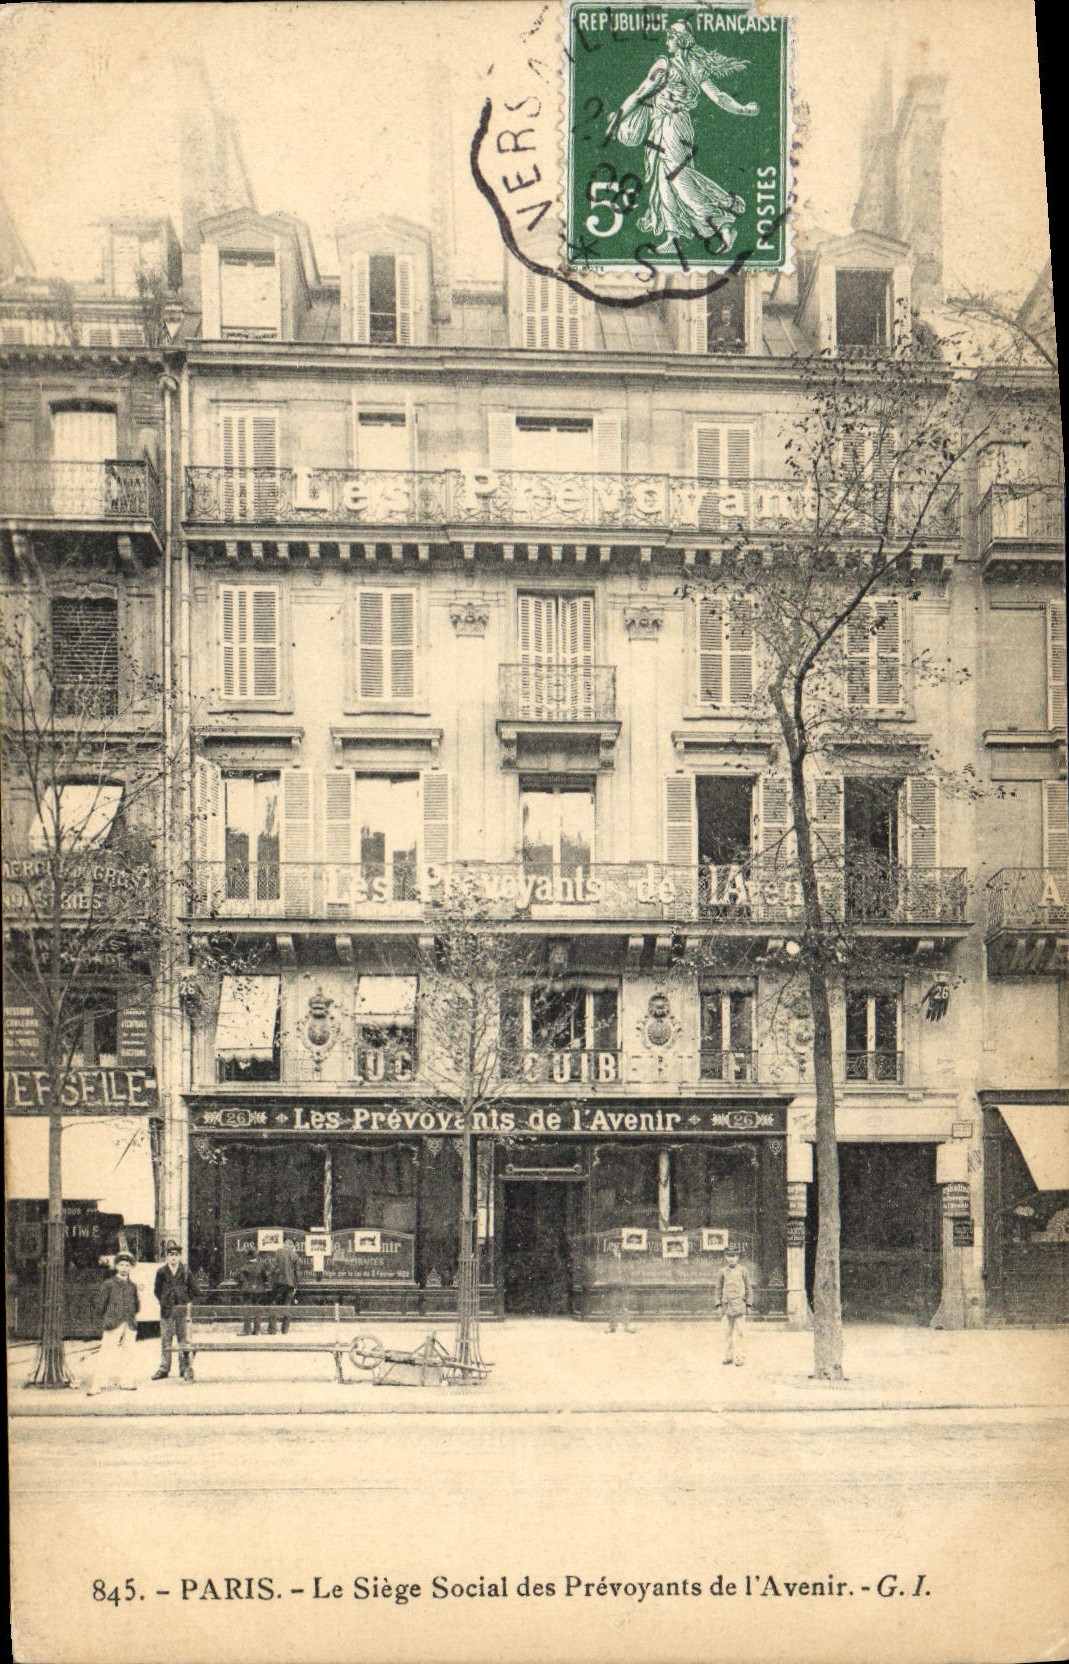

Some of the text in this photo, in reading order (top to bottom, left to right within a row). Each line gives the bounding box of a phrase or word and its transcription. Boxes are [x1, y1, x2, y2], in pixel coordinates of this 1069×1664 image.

[696, 12, 778, 35] FRANÇAISE
[757, 166, 777, 251] POSTES
[292, 466, 411, 513] Les
[326, 867, 387, 904] Les
[226, 1110, 246, 1125] 26
[293, 1108, 340, 1130] Les
[353, 1108, 515, 1132] Prévoyants
[529, 1109, 561, 1131] de
[573, 1109, 682, 1132] l'Avenir
